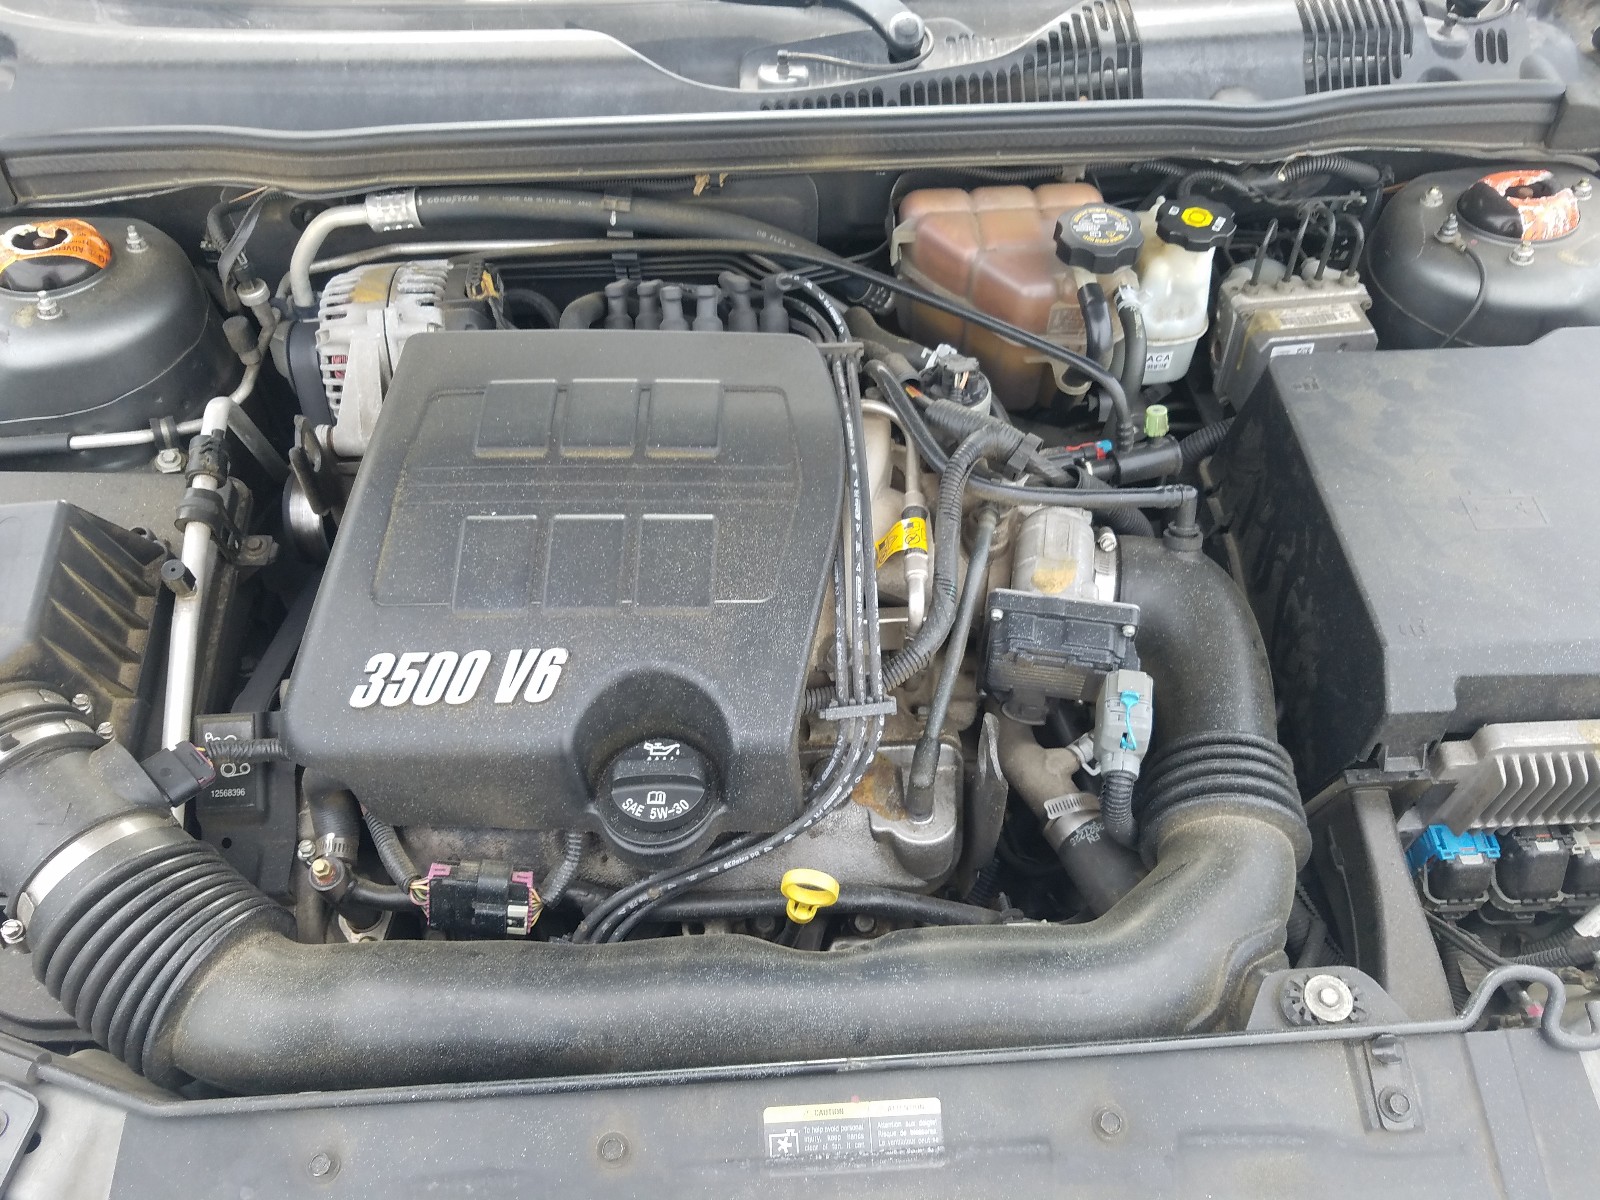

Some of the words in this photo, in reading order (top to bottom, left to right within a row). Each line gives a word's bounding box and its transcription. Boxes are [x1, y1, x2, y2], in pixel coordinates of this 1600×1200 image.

[427, 194, 480, 204] GOODYEAR
[349, 650, 491, 708] 3500
[494, 647, 569, 704] V6
[211, 788, 246, 798] 12568396
[621, 797, 645, 817] SAE
[649, 799, 690, 820] 5W-30
[814, 1108, 844, 1117] CAUTION
[812, 1126, 823, 1134] help
[824, 1125, 839, 1133] avoid
[840, 1123, 864, 1132] personal
